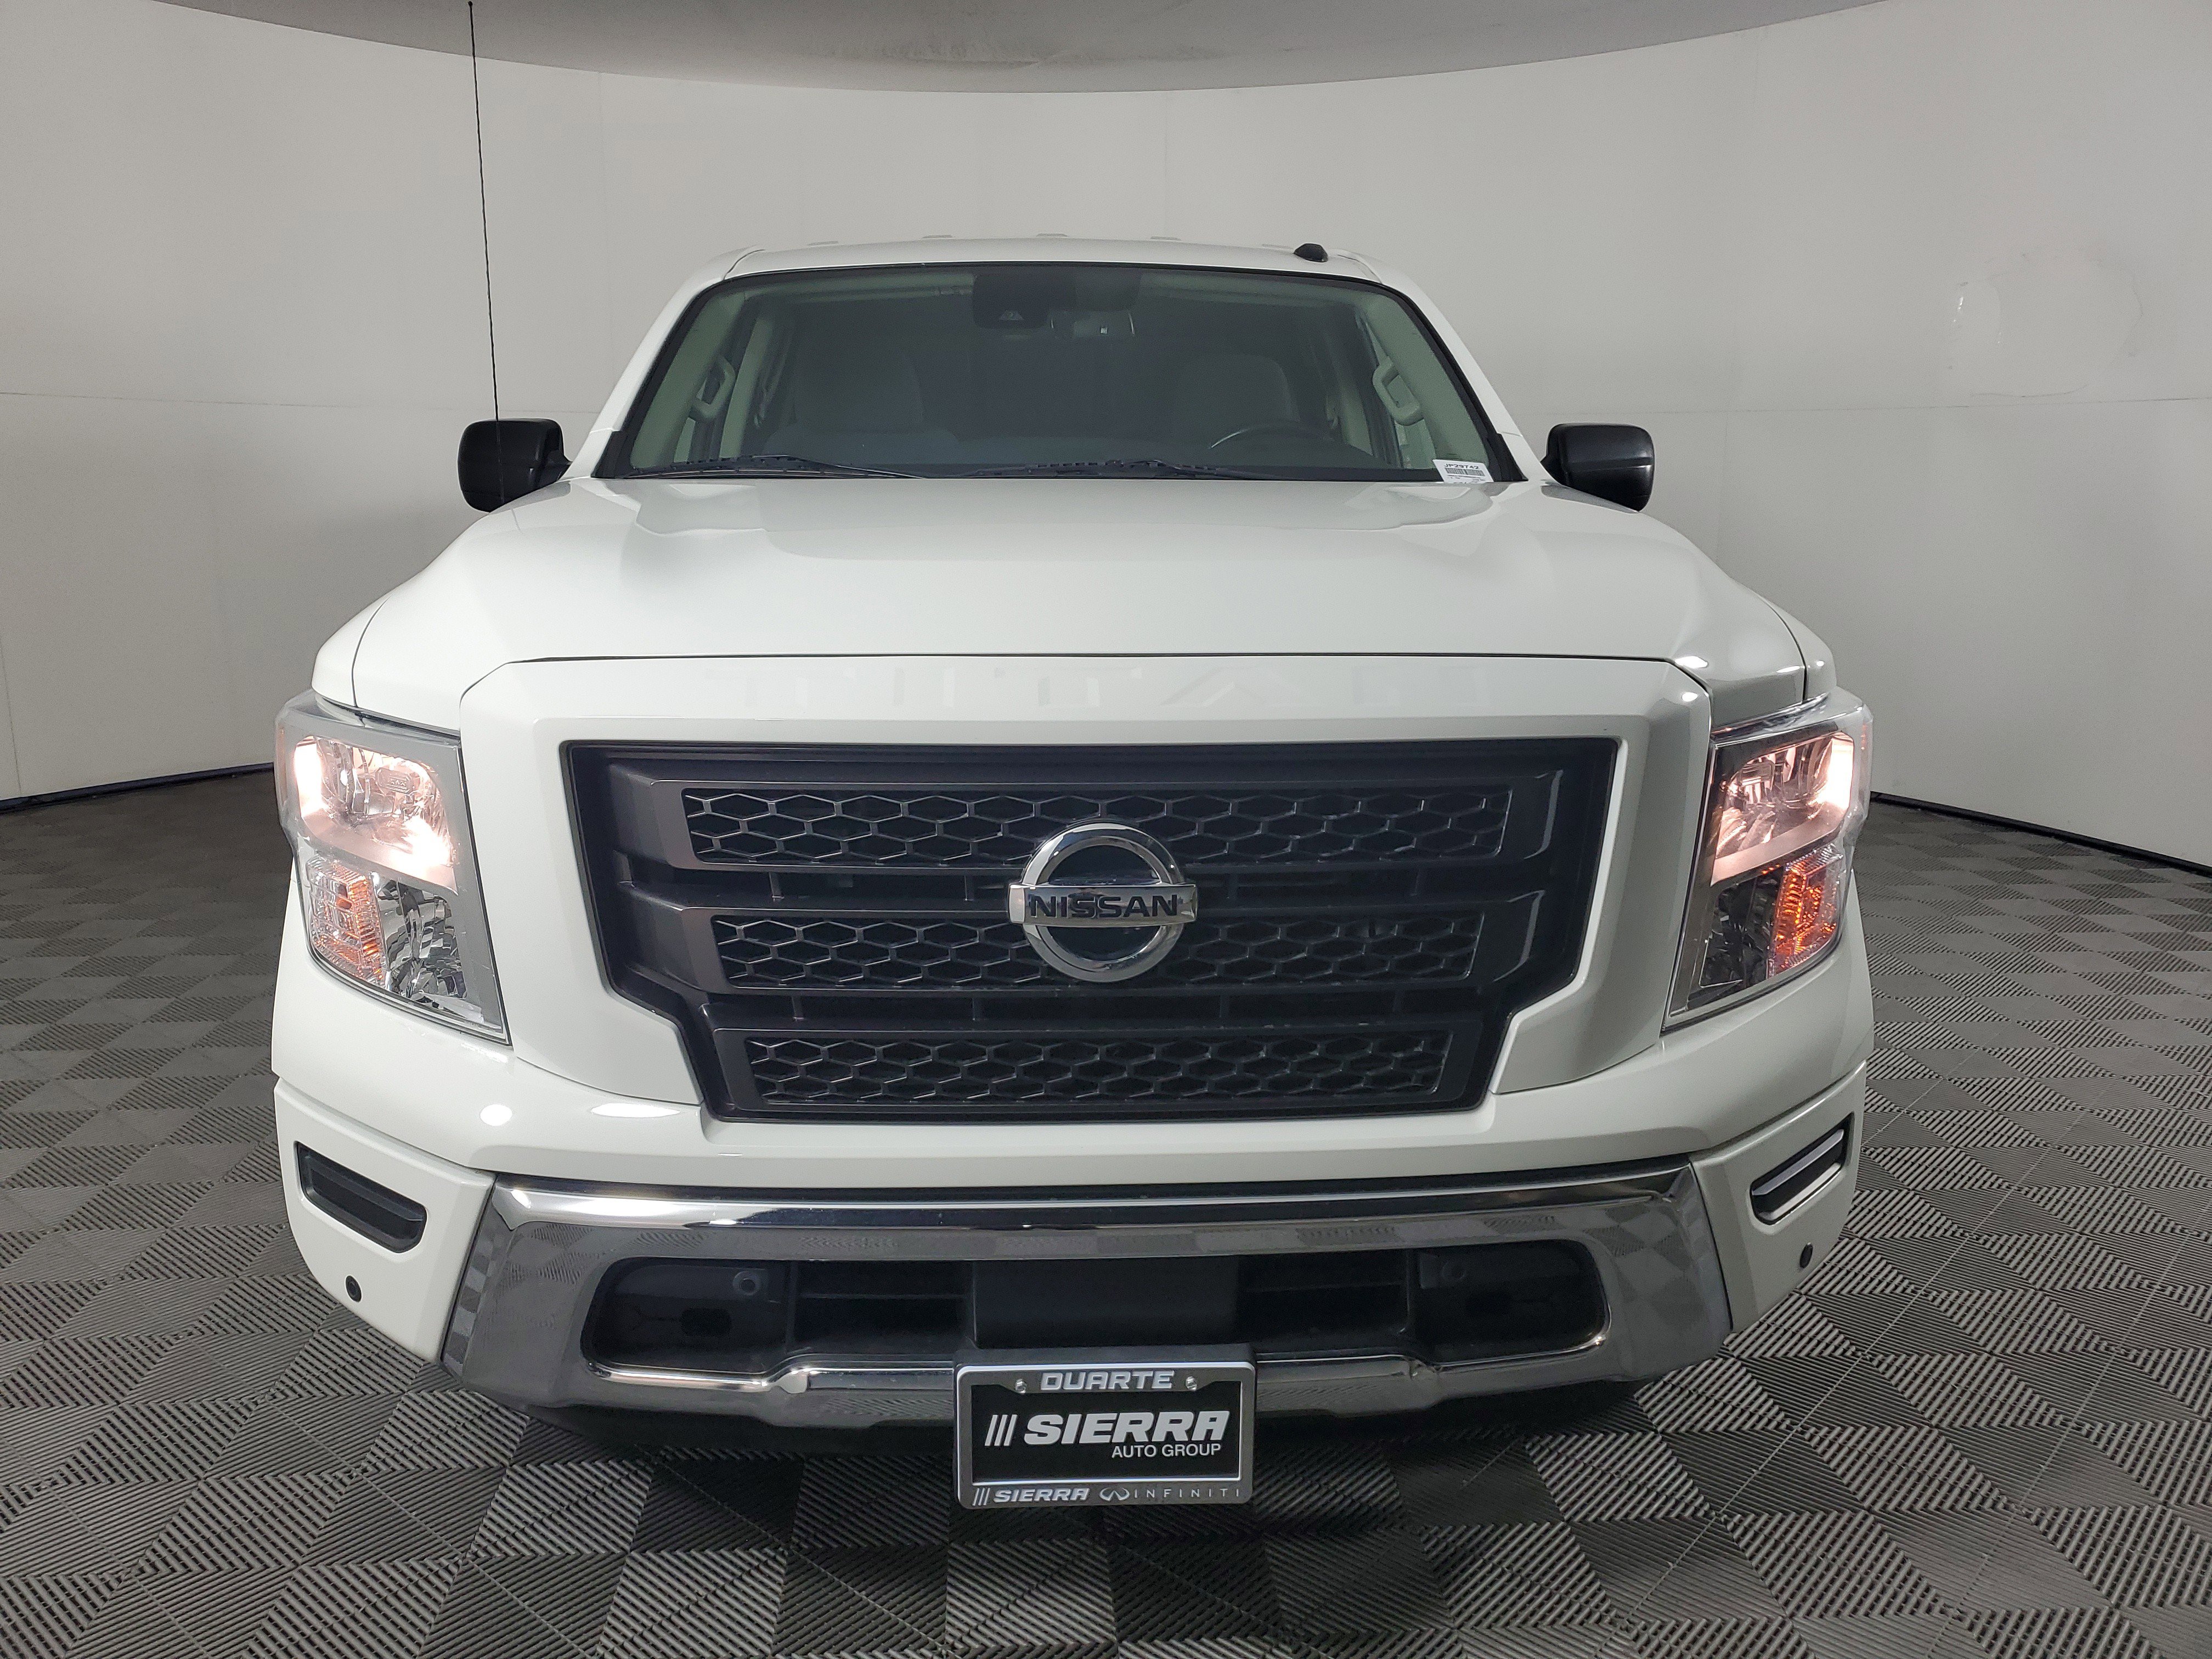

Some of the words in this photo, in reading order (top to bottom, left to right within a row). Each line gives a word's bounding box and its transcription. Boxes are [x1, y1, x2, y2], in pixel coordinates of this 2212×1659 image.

[1030, 894, 1178, 918] NISSAN
[1040, 1370, 1175, 1391] DUARTE
[1024, 1410, 1231, 1446] SIERRA
[1111, 1444, 1158, 1459] AUTO
[1161, 1443, 1221, 1457] GROUP
[994, 1487, 1091, 1503] SIERRA
[1134, 1488, 1240, 1499] INFINITI
